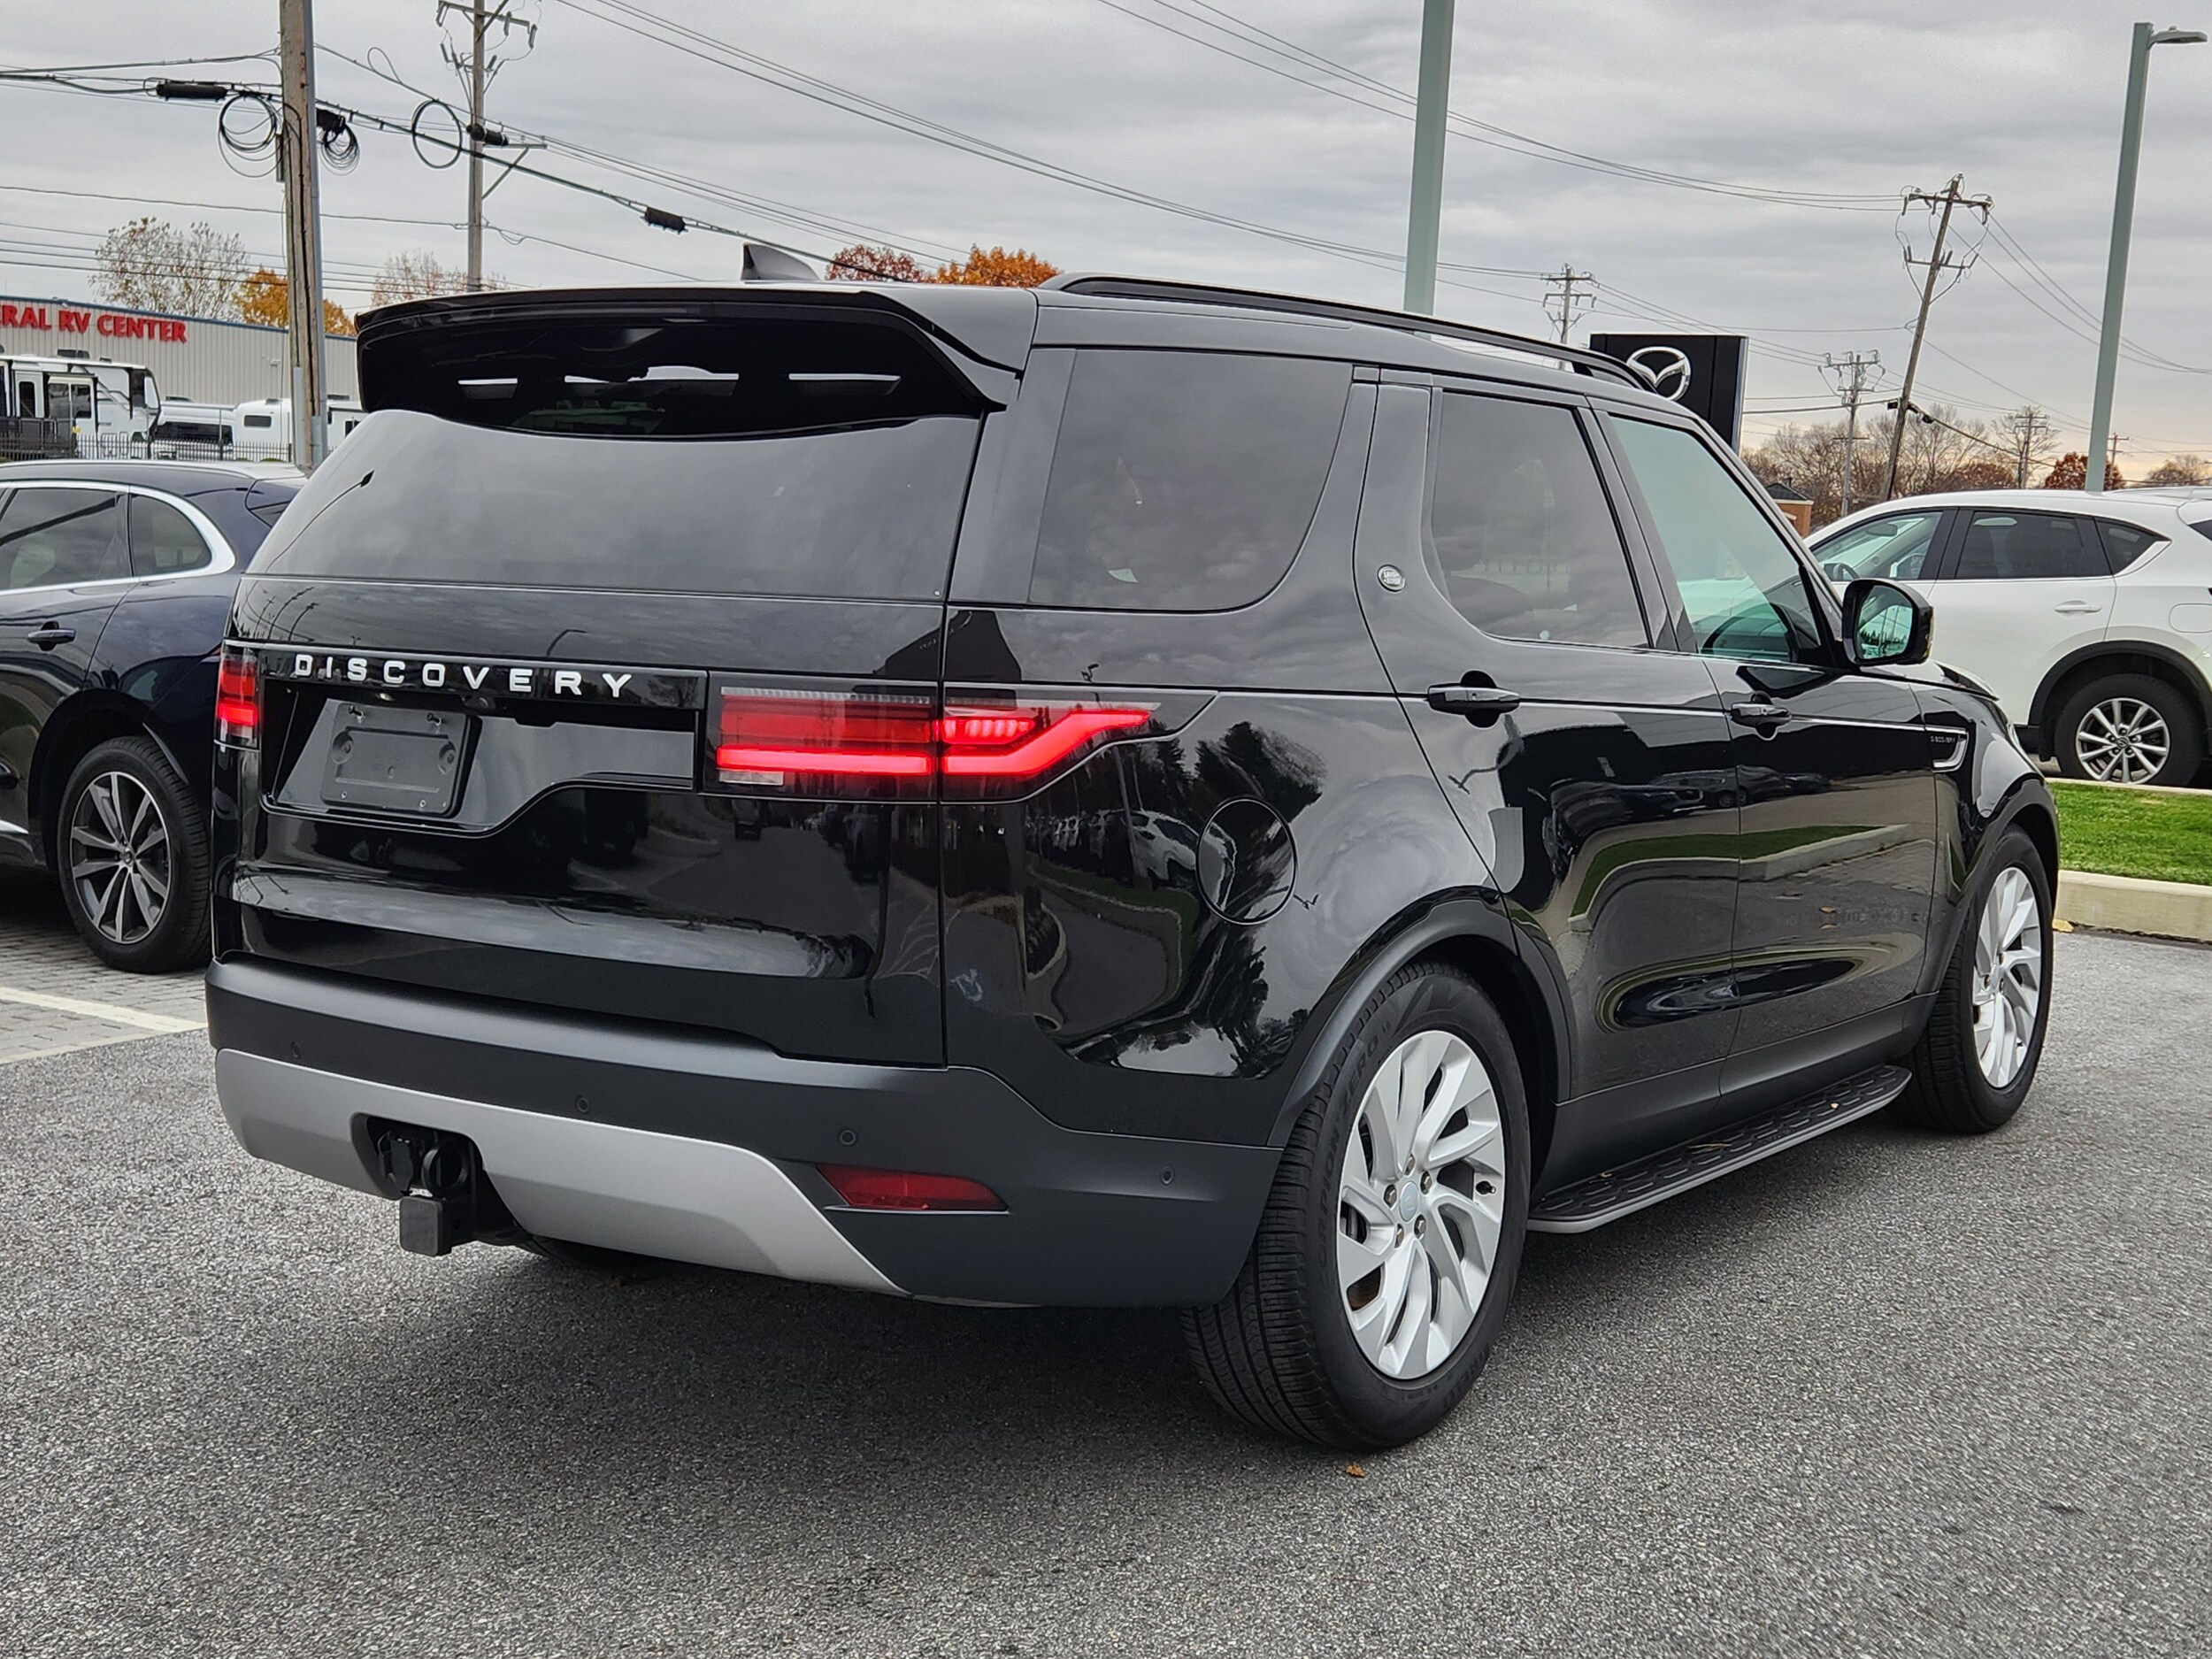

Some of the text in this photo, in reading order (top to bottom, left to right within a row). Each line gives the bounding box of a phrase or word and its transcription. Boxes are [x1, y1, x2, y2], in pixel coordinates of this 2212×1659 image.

[0, 304, 188, 343] RAL RV CENTER
[295, 654, 632, 698] DISCOVERY
